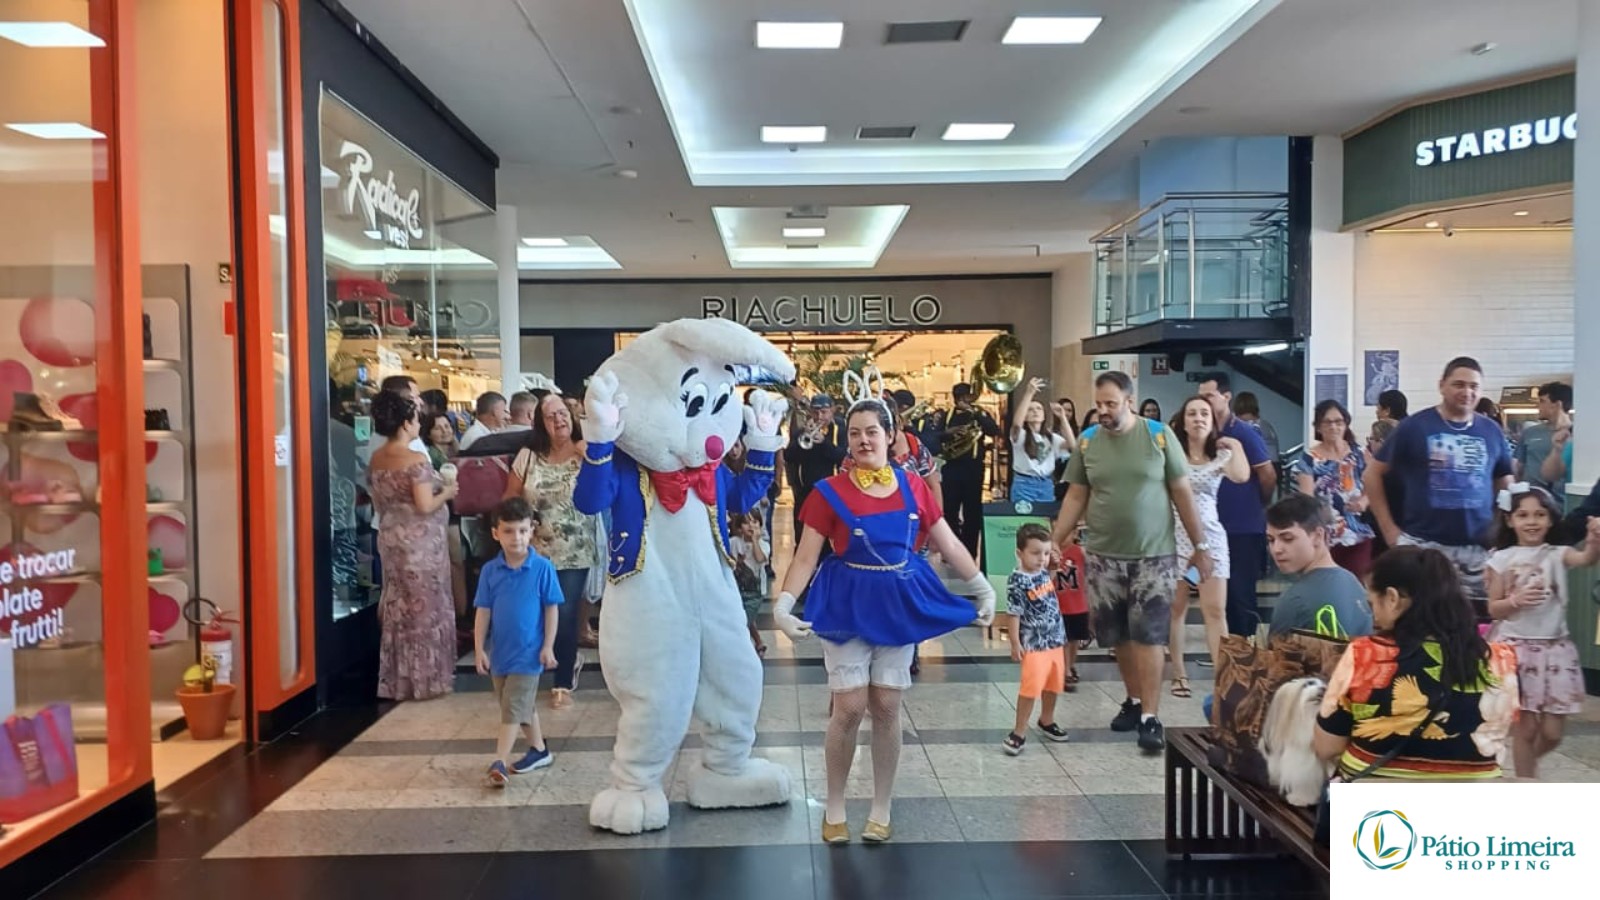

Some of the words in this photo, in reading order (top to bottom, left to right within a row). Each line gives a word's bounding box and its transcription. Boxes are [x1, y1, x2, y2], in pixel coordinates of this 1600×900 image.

[340, 140, 424, 240] Radical
[700, 293, 942, 326] RIACHUELO
[17, 548, 76, 579] trocar
[1056, 565, 1079, 591] M
[10, 606, 64, 650] frutti!
